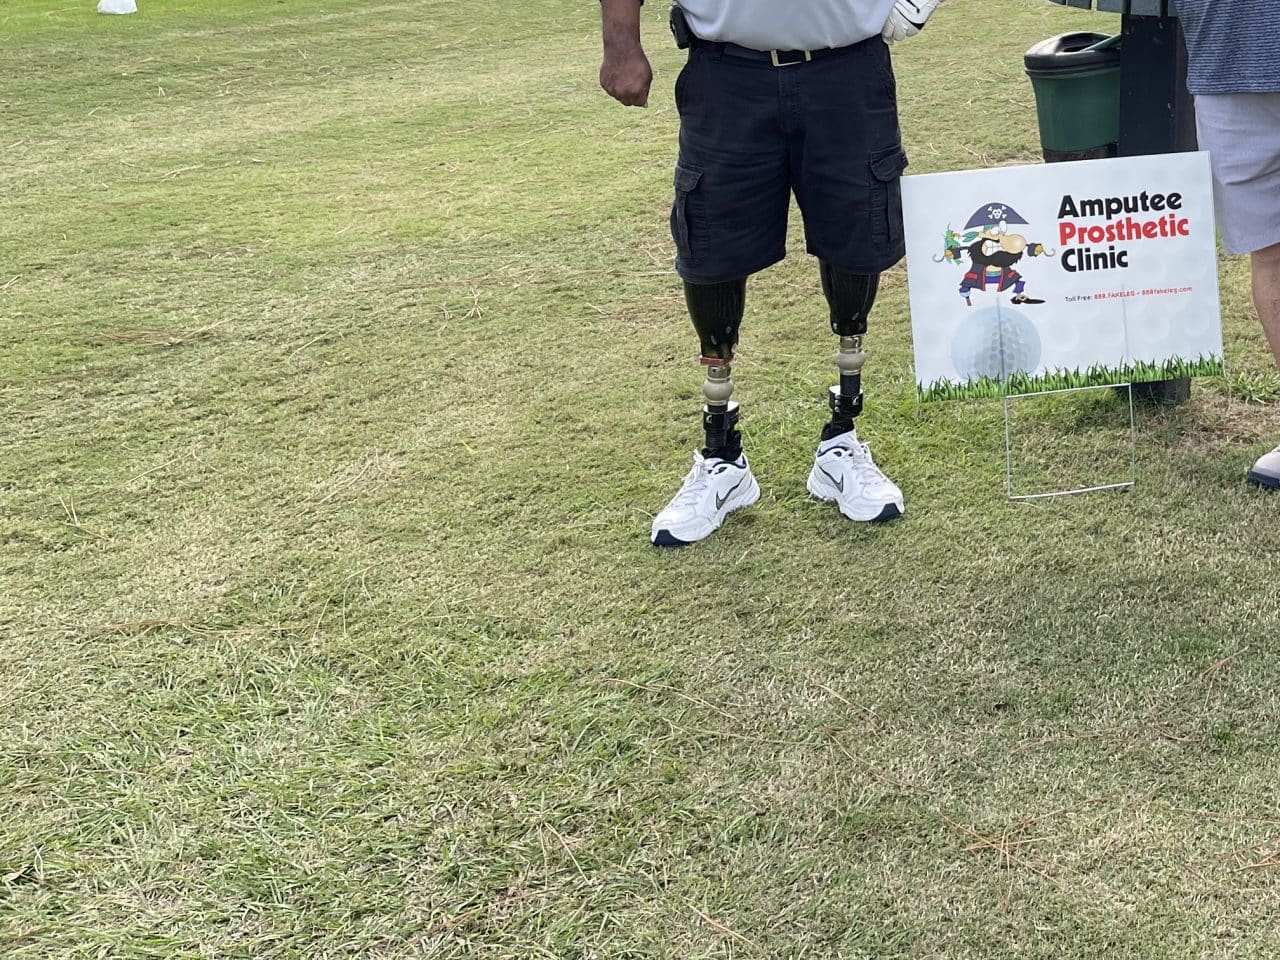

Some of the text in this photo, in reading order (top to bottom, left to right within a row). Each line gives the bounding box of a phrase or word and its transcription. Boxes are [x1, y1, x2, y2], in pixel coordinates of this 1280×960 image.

[1057, 190, 1182, 220] Amputee
[1059, 213, 1190, 246] Prosthetic
[1061, 245, 1128, 272] Clinic
